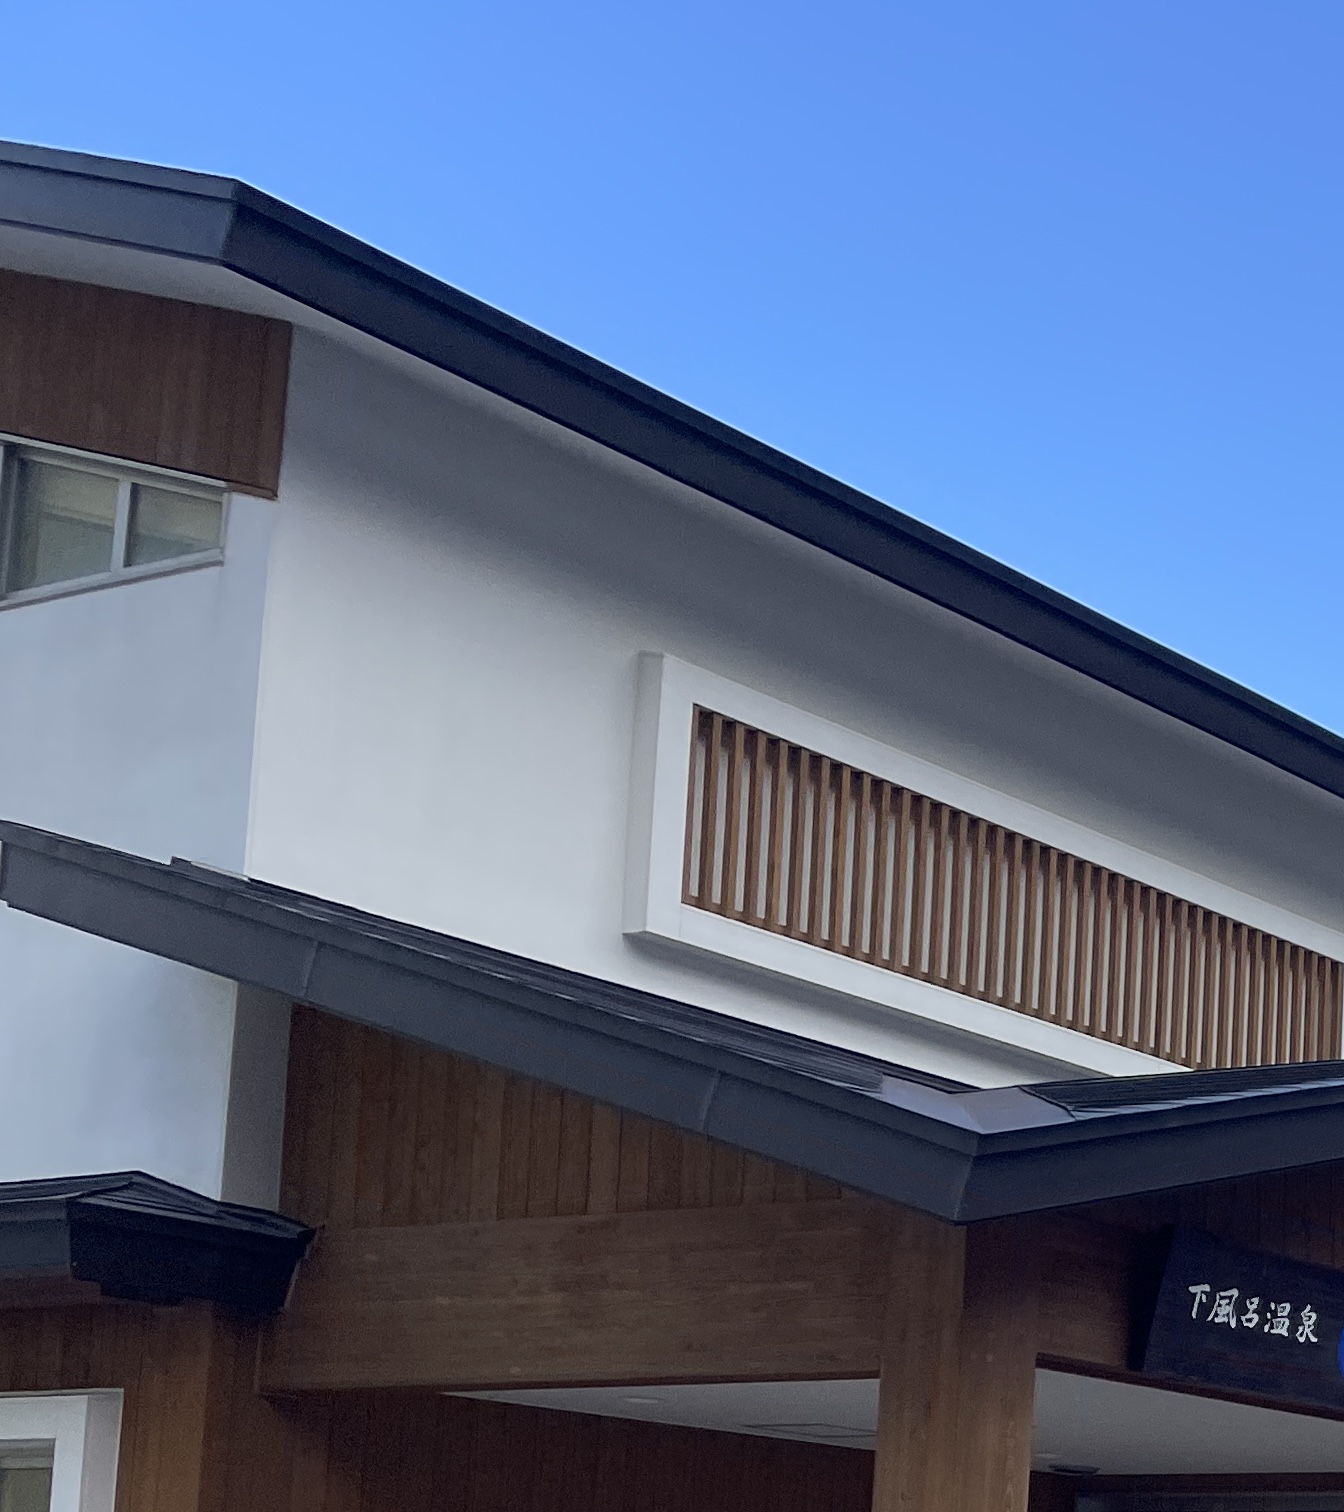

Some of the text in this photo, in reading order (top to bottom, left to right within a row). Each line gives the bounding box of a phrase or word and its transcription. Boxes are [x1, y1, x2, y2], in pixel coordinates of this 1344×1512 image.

[1188, 1283, 1319, 1343] 下風呂温泉
